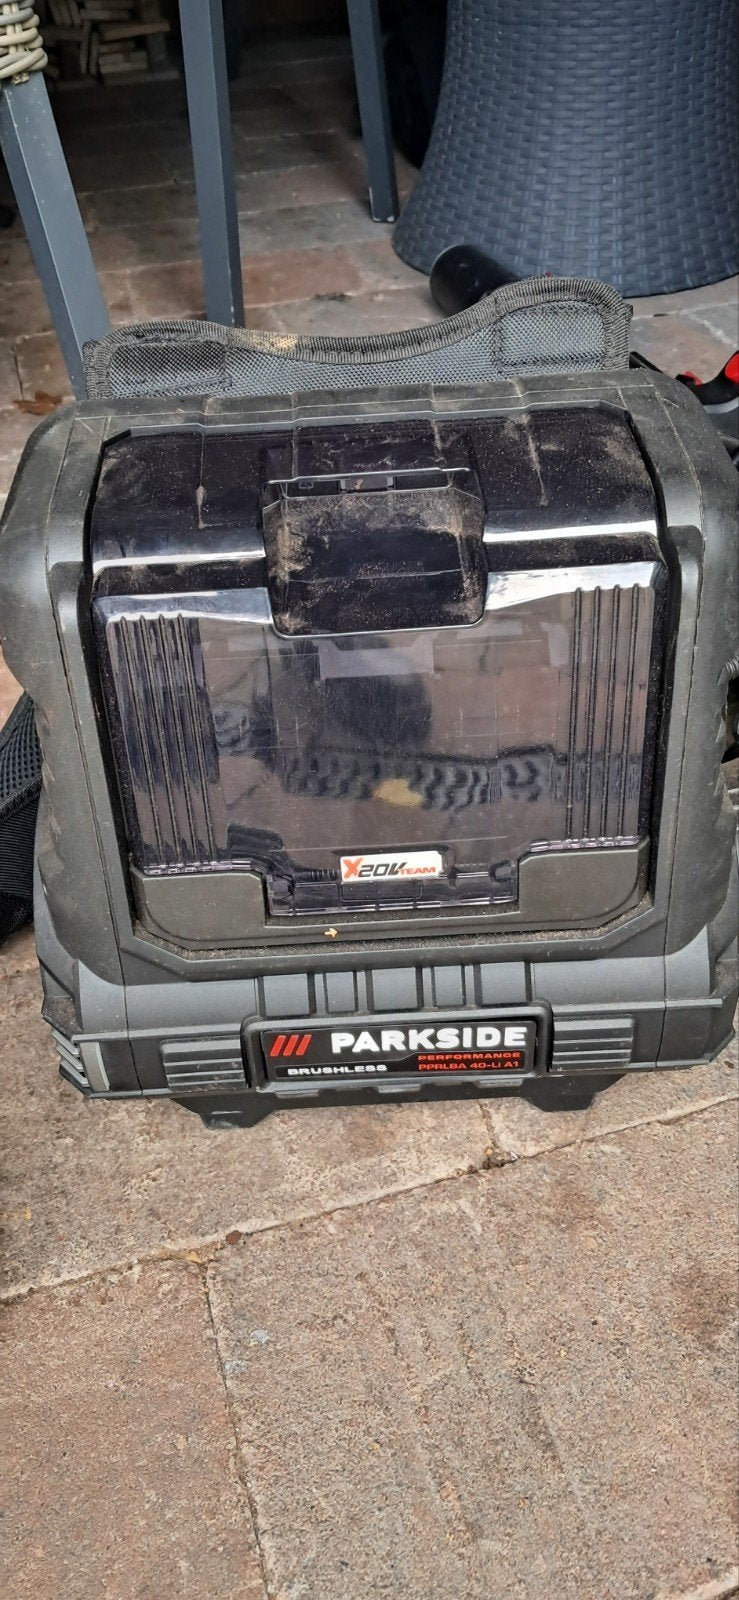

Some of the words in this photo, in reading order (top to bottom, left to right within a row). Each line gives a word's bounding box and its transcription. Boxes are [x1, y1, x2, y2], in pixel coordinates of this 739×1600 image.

[399, 867, 436, 875] TEAM
[331, 1026, 528, 1054] PARKSIDE
[417, 1052, 521, 1061] PERFORMANCE
[287, 1064, 388, 1076] BRUSHLESS
[418, 1062, 467, 1071] PPRLBA
